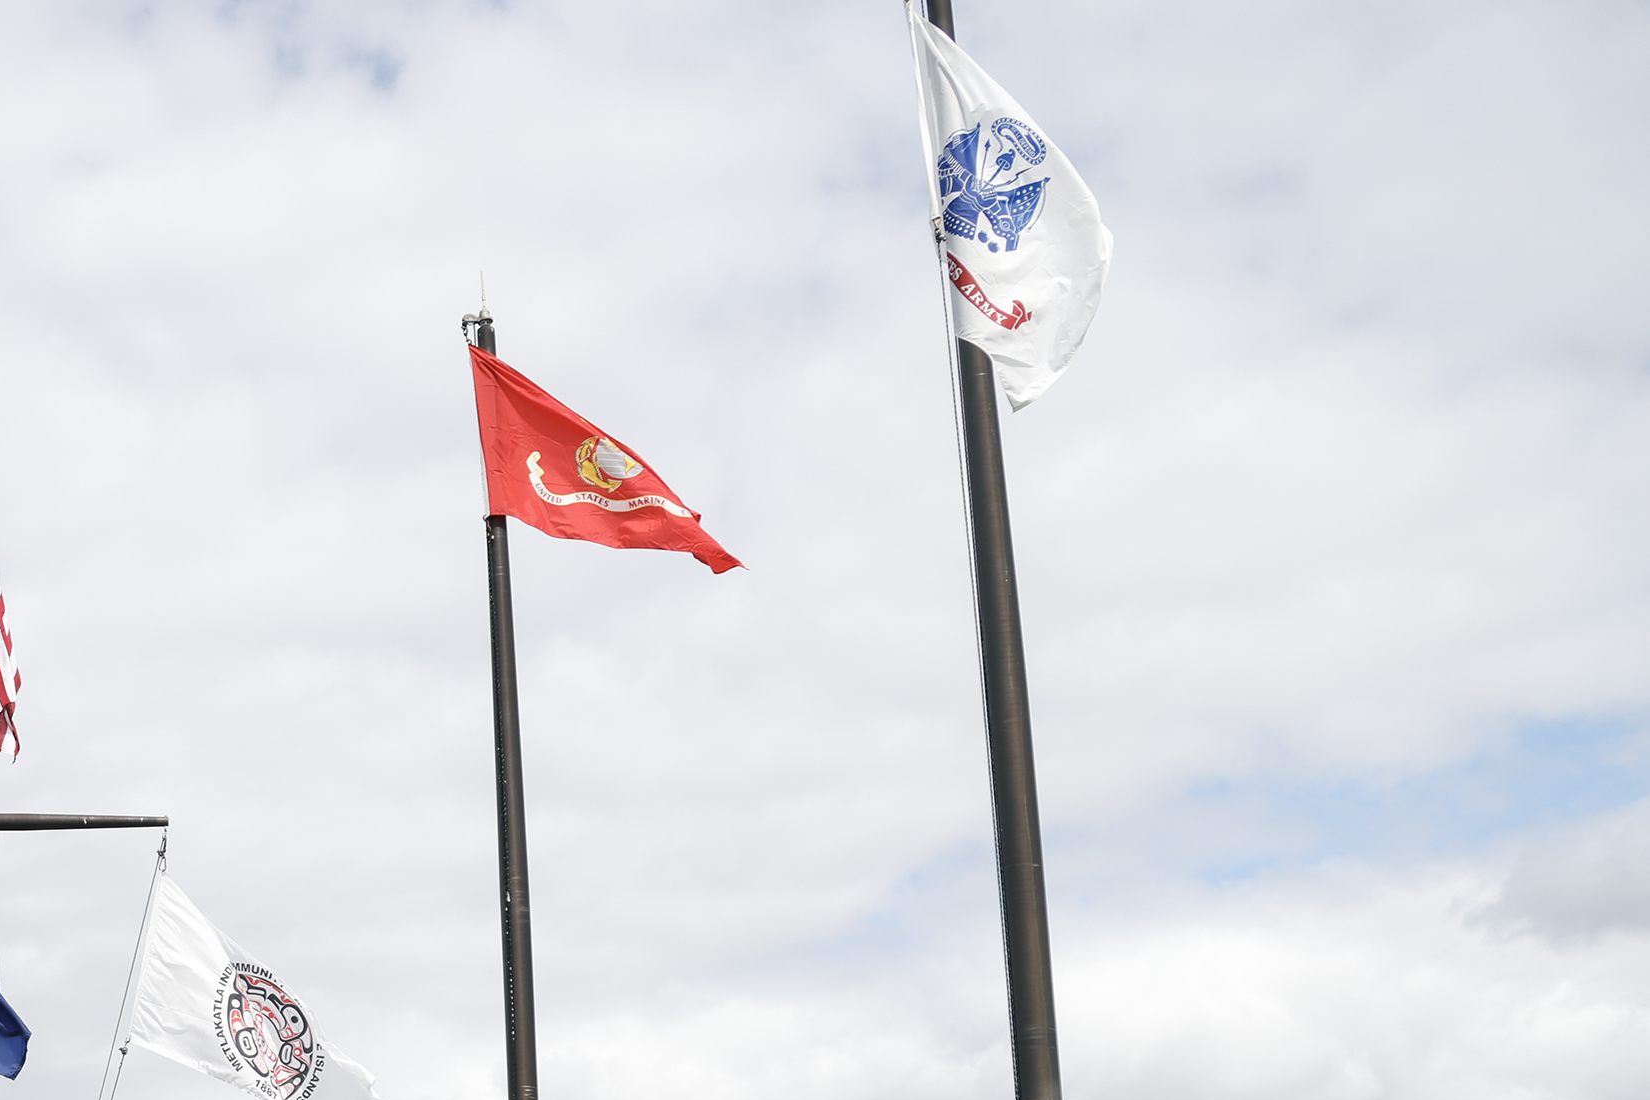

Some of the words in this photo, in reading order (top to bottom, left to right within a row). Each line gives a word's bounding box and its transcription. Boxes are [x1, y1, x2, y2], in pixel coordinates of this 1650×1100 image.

[961, 283, 1008, 324] ARMY
[535, 482, 562, 503] UNITED
[575, 493, 609, 508] STATES
[629, 497, 667, 508] MARINE
[213, 989, 244, 1072] METLAKATLA
[255, 1080, 278, 1100] 1887
